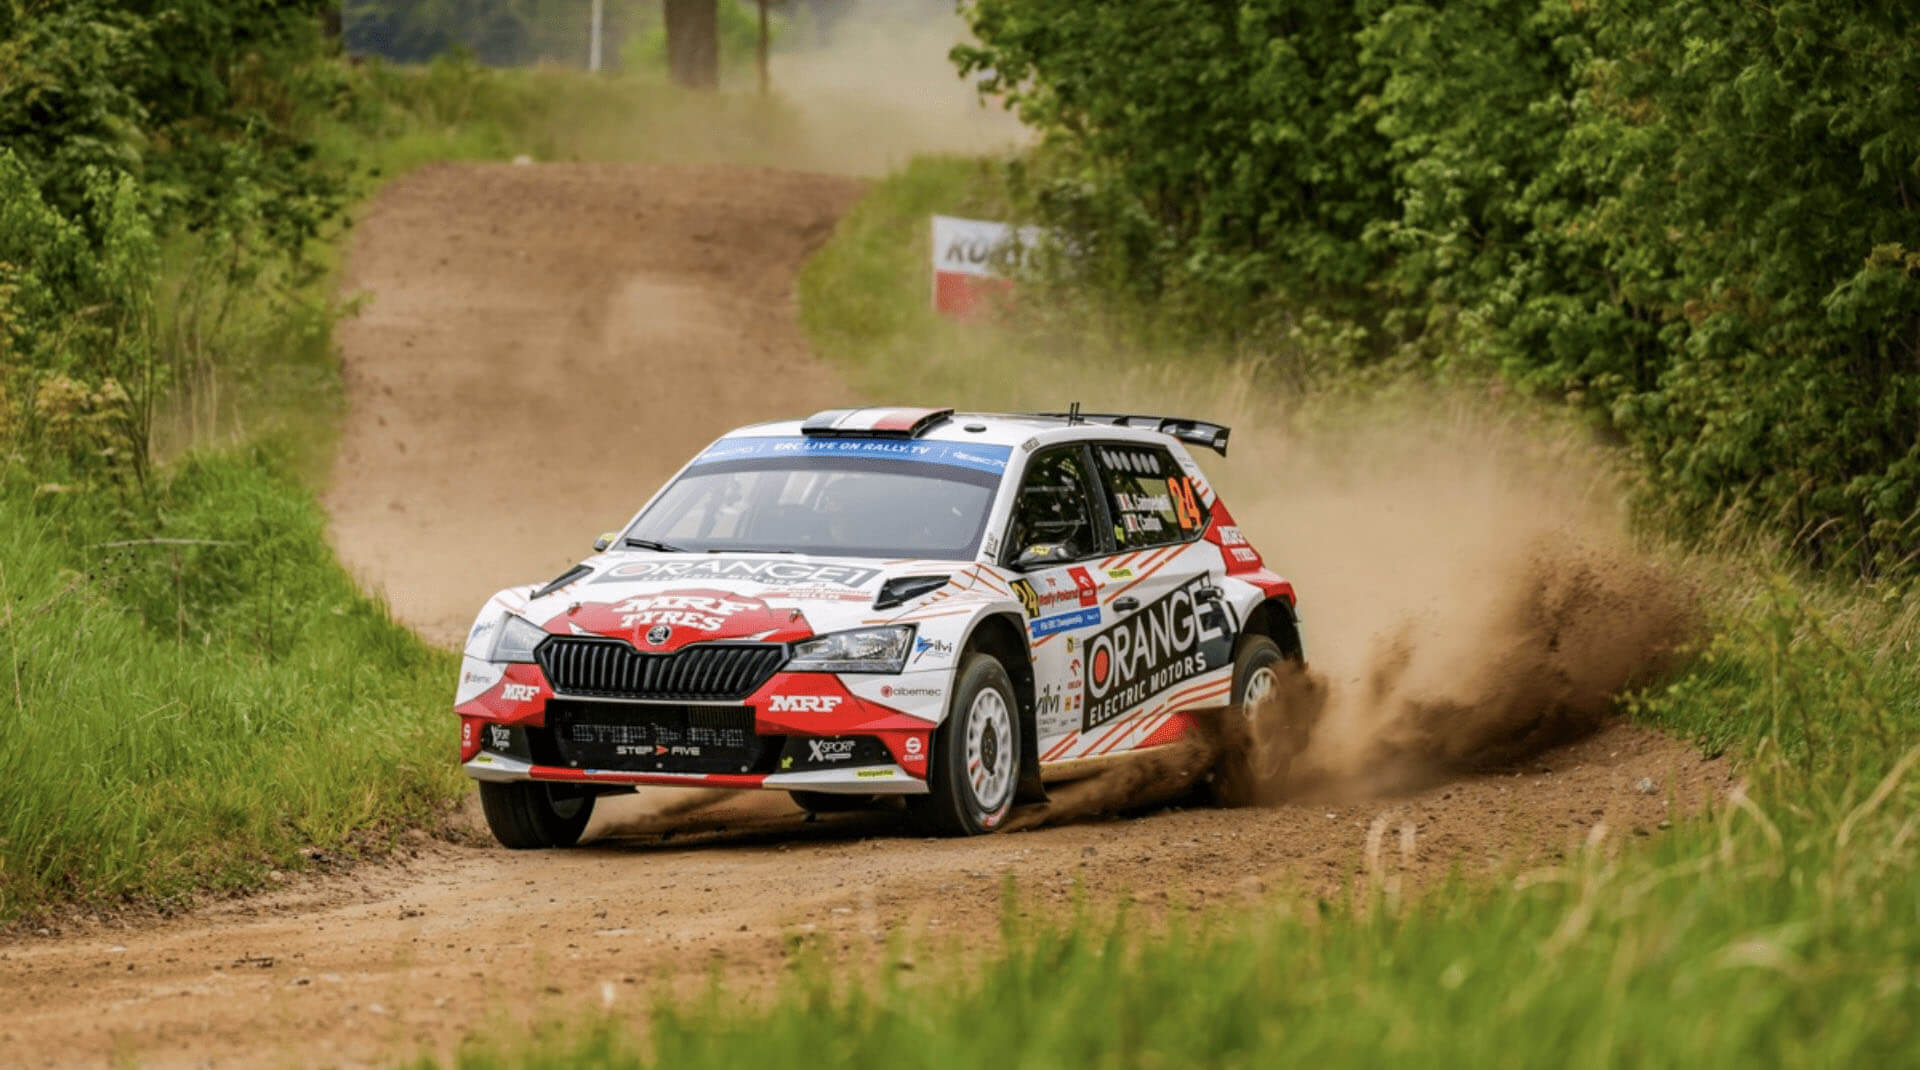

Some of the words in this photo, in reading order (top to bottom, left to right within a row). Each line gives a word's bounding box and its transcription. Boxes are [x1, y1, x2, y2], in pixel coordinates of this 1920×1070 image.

[803, 441, 836, 451] LIVE
[840, 442, 861, 451] ON
[863, 442, 931, 455] RALLY.TV
[1168, 476, 1202, 530] 24
[608, 559, 871, 585] ORANGE1
[612, 595, 761, 616] MRF
[1012, 580, 1039, 617] 24
[620, 611, 726, 631] TYRES
[501, 683, 540, 702] MRF
[1089, 680, 1147, 727] ELECTRIC
[1151, 651, 1208, 694] MOTORS
[767, 695, 843, 713] MRF
[616, 745, 654, 755] STEP
[671, 746, 701, 756] FIVE
